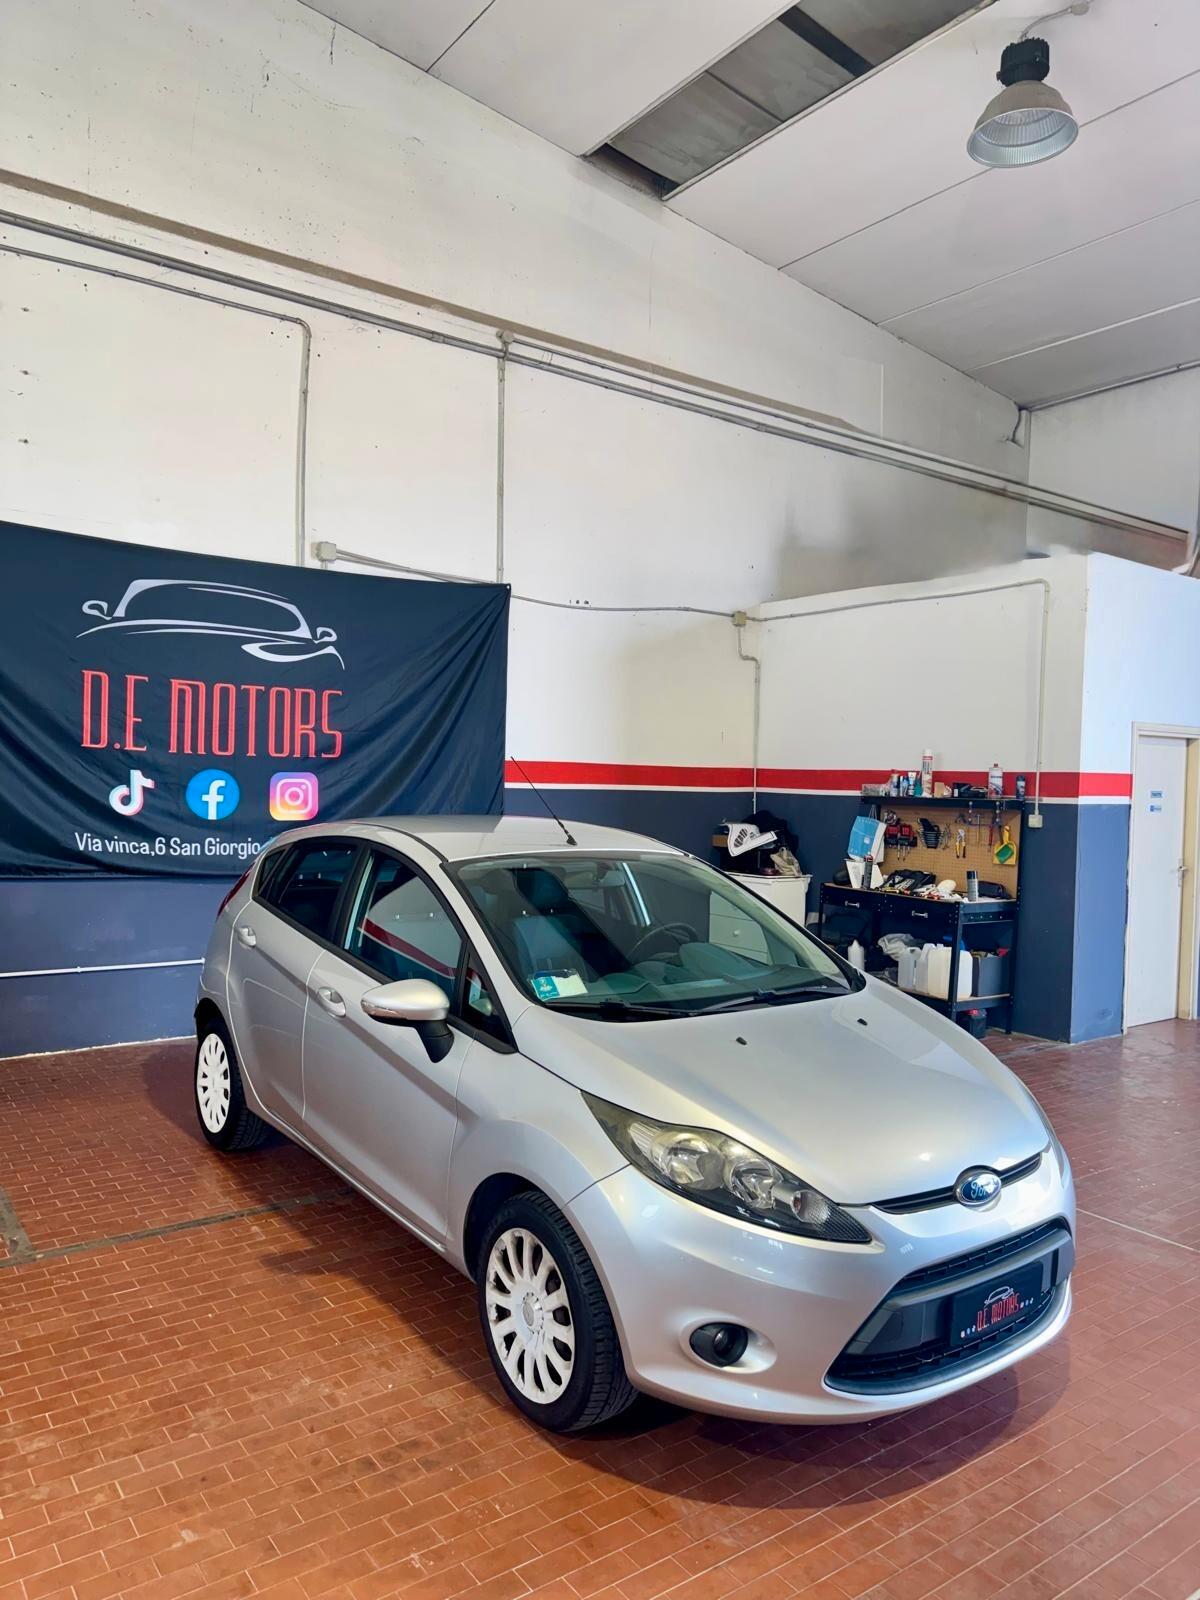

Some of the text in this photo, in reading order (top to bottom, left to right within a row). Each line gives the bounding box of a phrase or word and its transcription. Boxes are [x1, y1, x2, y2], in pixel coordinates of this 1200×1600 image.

[80, 669, 343, 758] D.E MOTORS
[74, 832, 102, 852] Via
[169, 837, 201, 856] San
[204, 837, 261, 860] Giorgio
